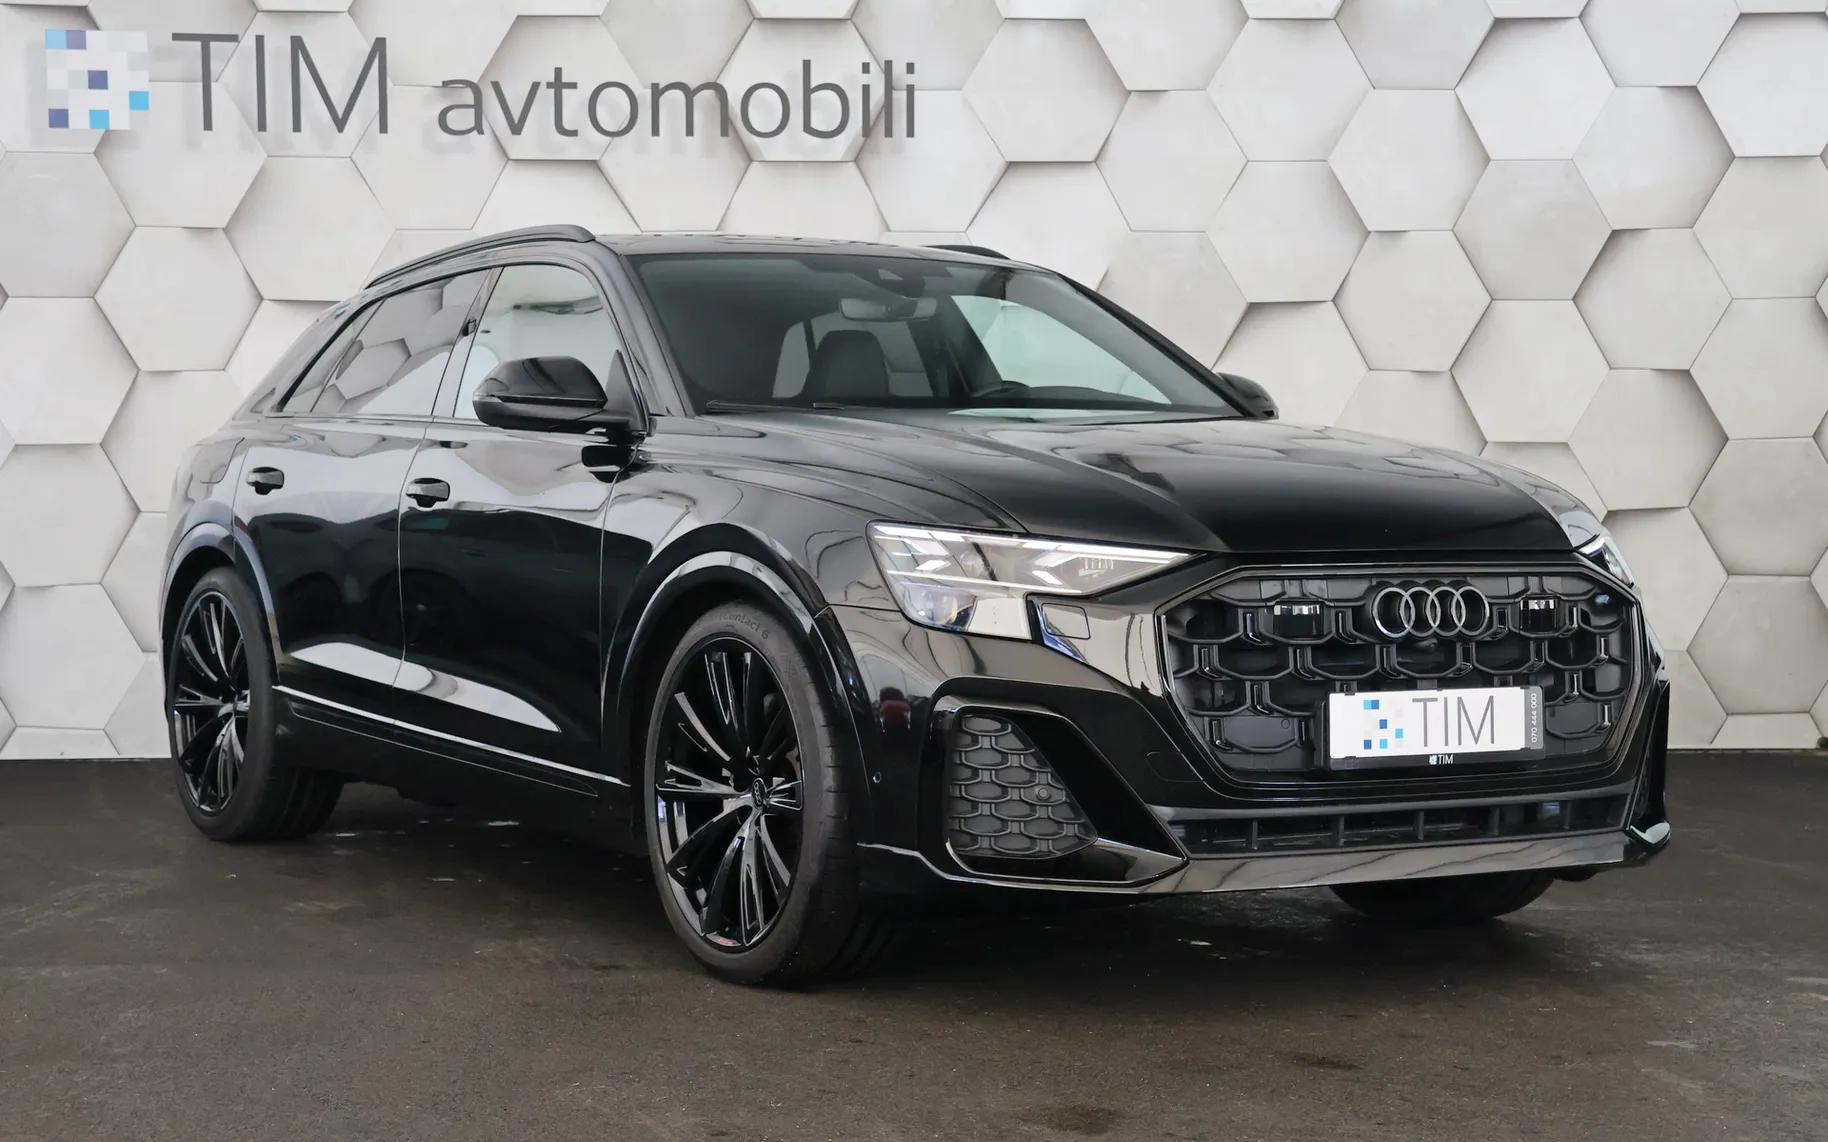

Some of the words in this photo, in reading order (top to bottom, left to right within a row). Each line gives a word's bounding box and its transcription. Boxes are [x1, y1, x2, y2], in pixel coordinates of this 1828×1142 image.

[172, 32, 388, 134] TIM
[437, 59, 915, 139] avtomobili
[1530, 692, 1538, 709] 000
[1412, 695, 1495, 748] TIM
[1530, 727, 1538, 743] 070
[1437, 754, 1454, 765] TIM
